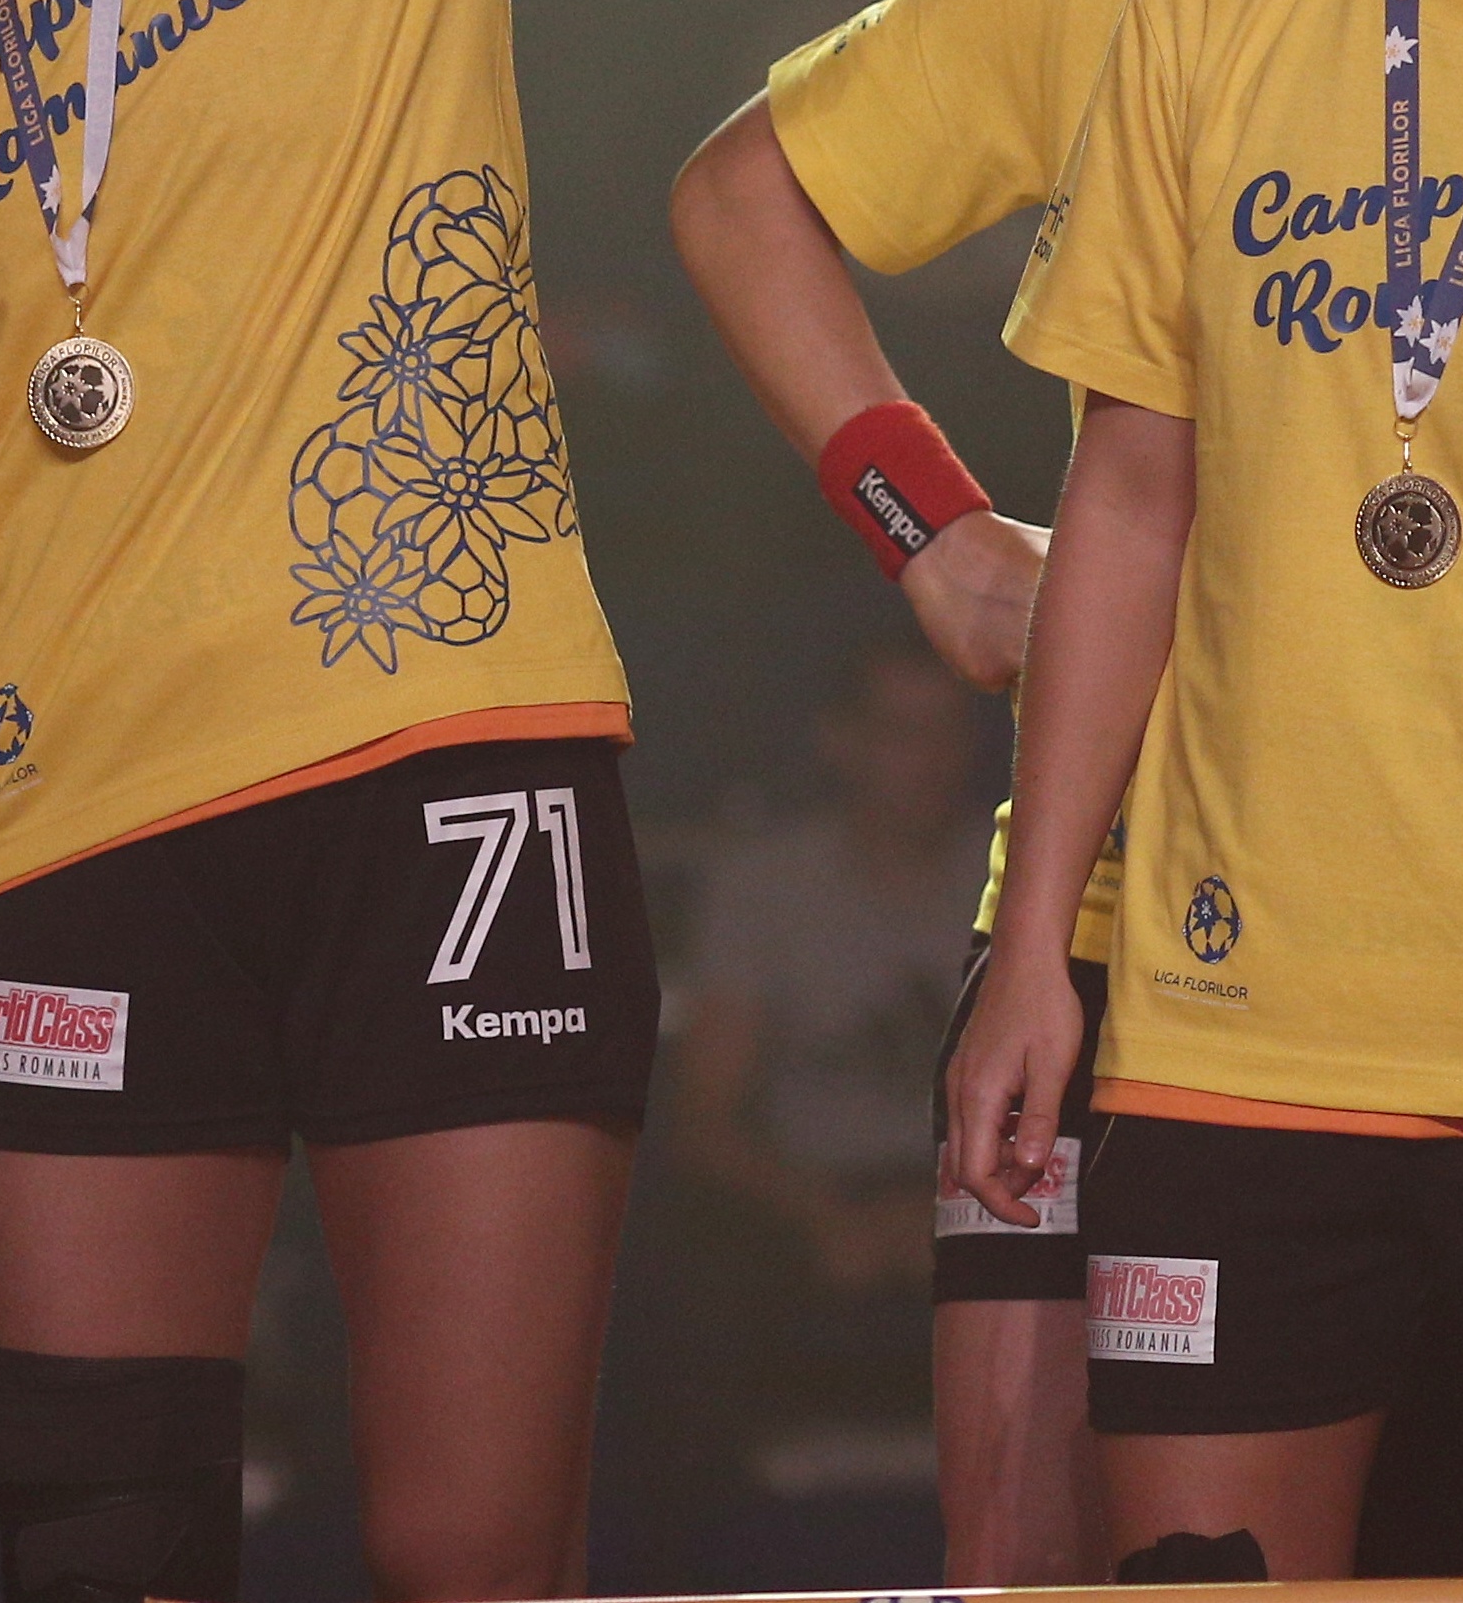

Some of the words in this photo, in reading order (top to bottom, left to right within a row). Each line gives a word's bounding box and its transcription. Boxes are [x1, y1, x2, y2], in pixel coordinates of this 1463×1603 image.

[21, 93, 45, 146] LIGA
[1392, 99, 1411, 208] FLORILOR
[1394, 214, 1413, 268] LIGA
[58, 343, 119, 369] FLORILOR
[859, 467, 927, 550] Kempa
[423, 787, 592, 985] 71
[1153, 969, 1181, 986] LIGA
[1183, 976, 1249, 1000] FLORILOR
[32, 991, 117, 1054] Class
[441, 1003, 587, 1044] Kempa
[19, 1055, 102, 1081] ROMANIA
[1126, 1263, 1206, 1326] Class
[1117, 1329, 1191, 1353] ROMANIA
